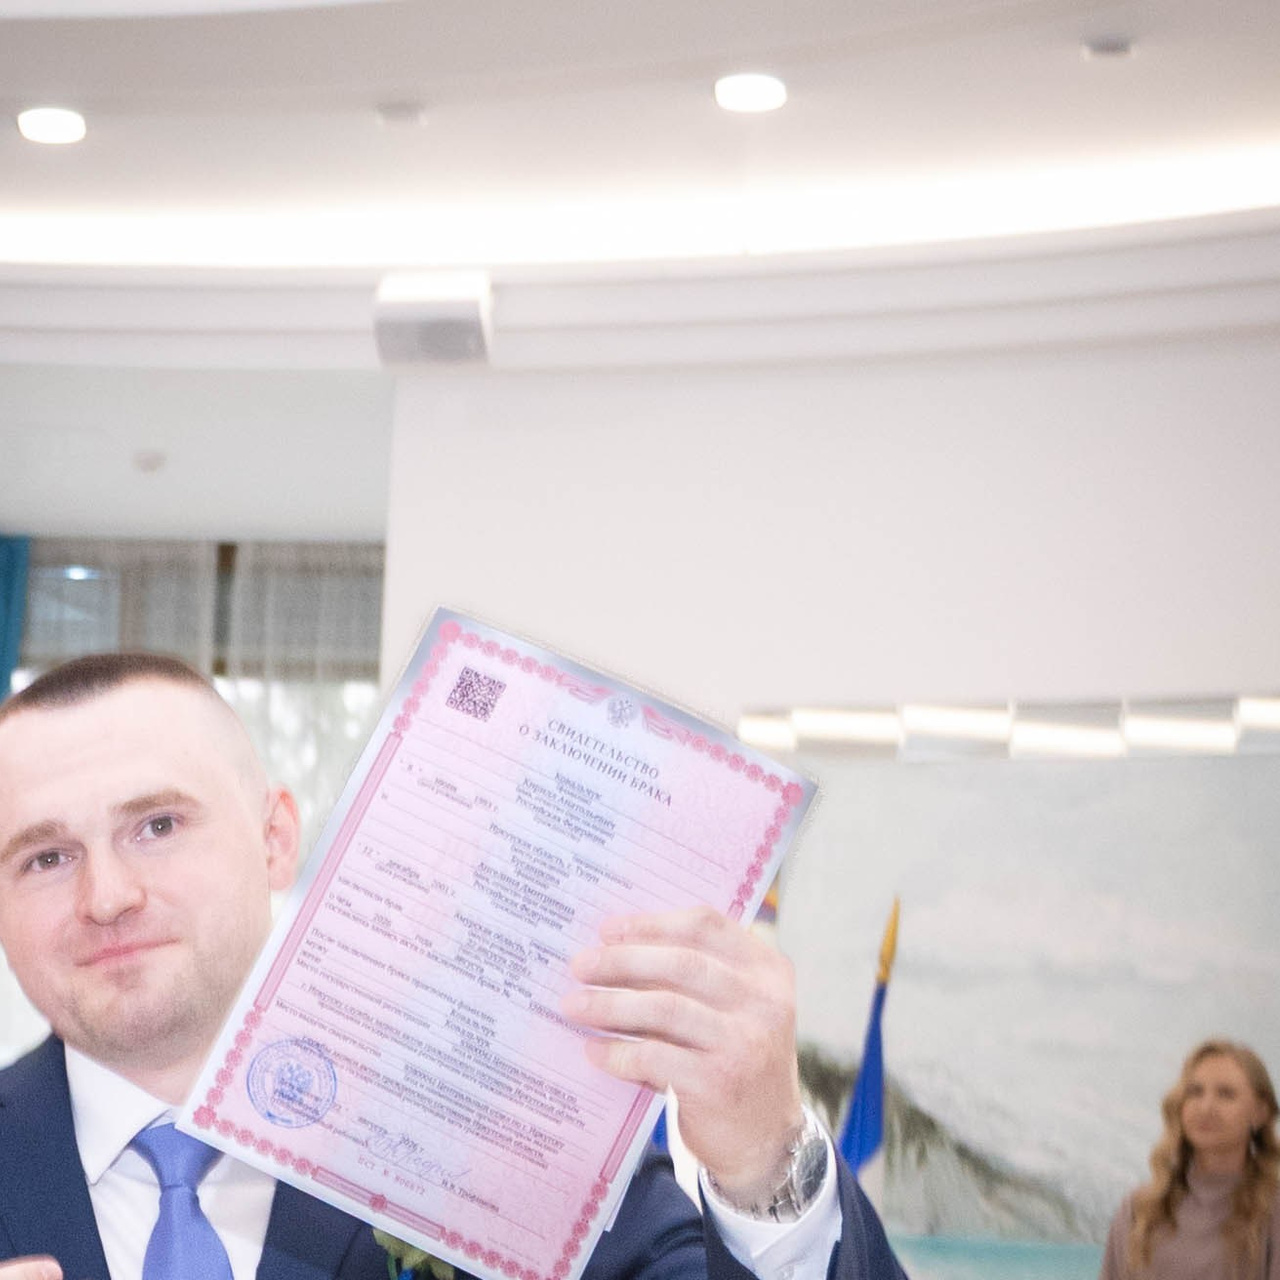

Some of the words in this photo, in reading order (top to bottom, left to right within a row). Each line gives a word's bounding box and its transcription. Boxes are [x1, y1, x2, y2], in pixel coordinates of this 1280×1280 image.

[516, 722, 531, 737] О
[530, 728, 629, 784] ЗАКЛЮЧЕНИИ
[628, 776, 675, 807] БРАКА
[545, 717, 661, 781] СВИДЕТЕЛЬСТВО
